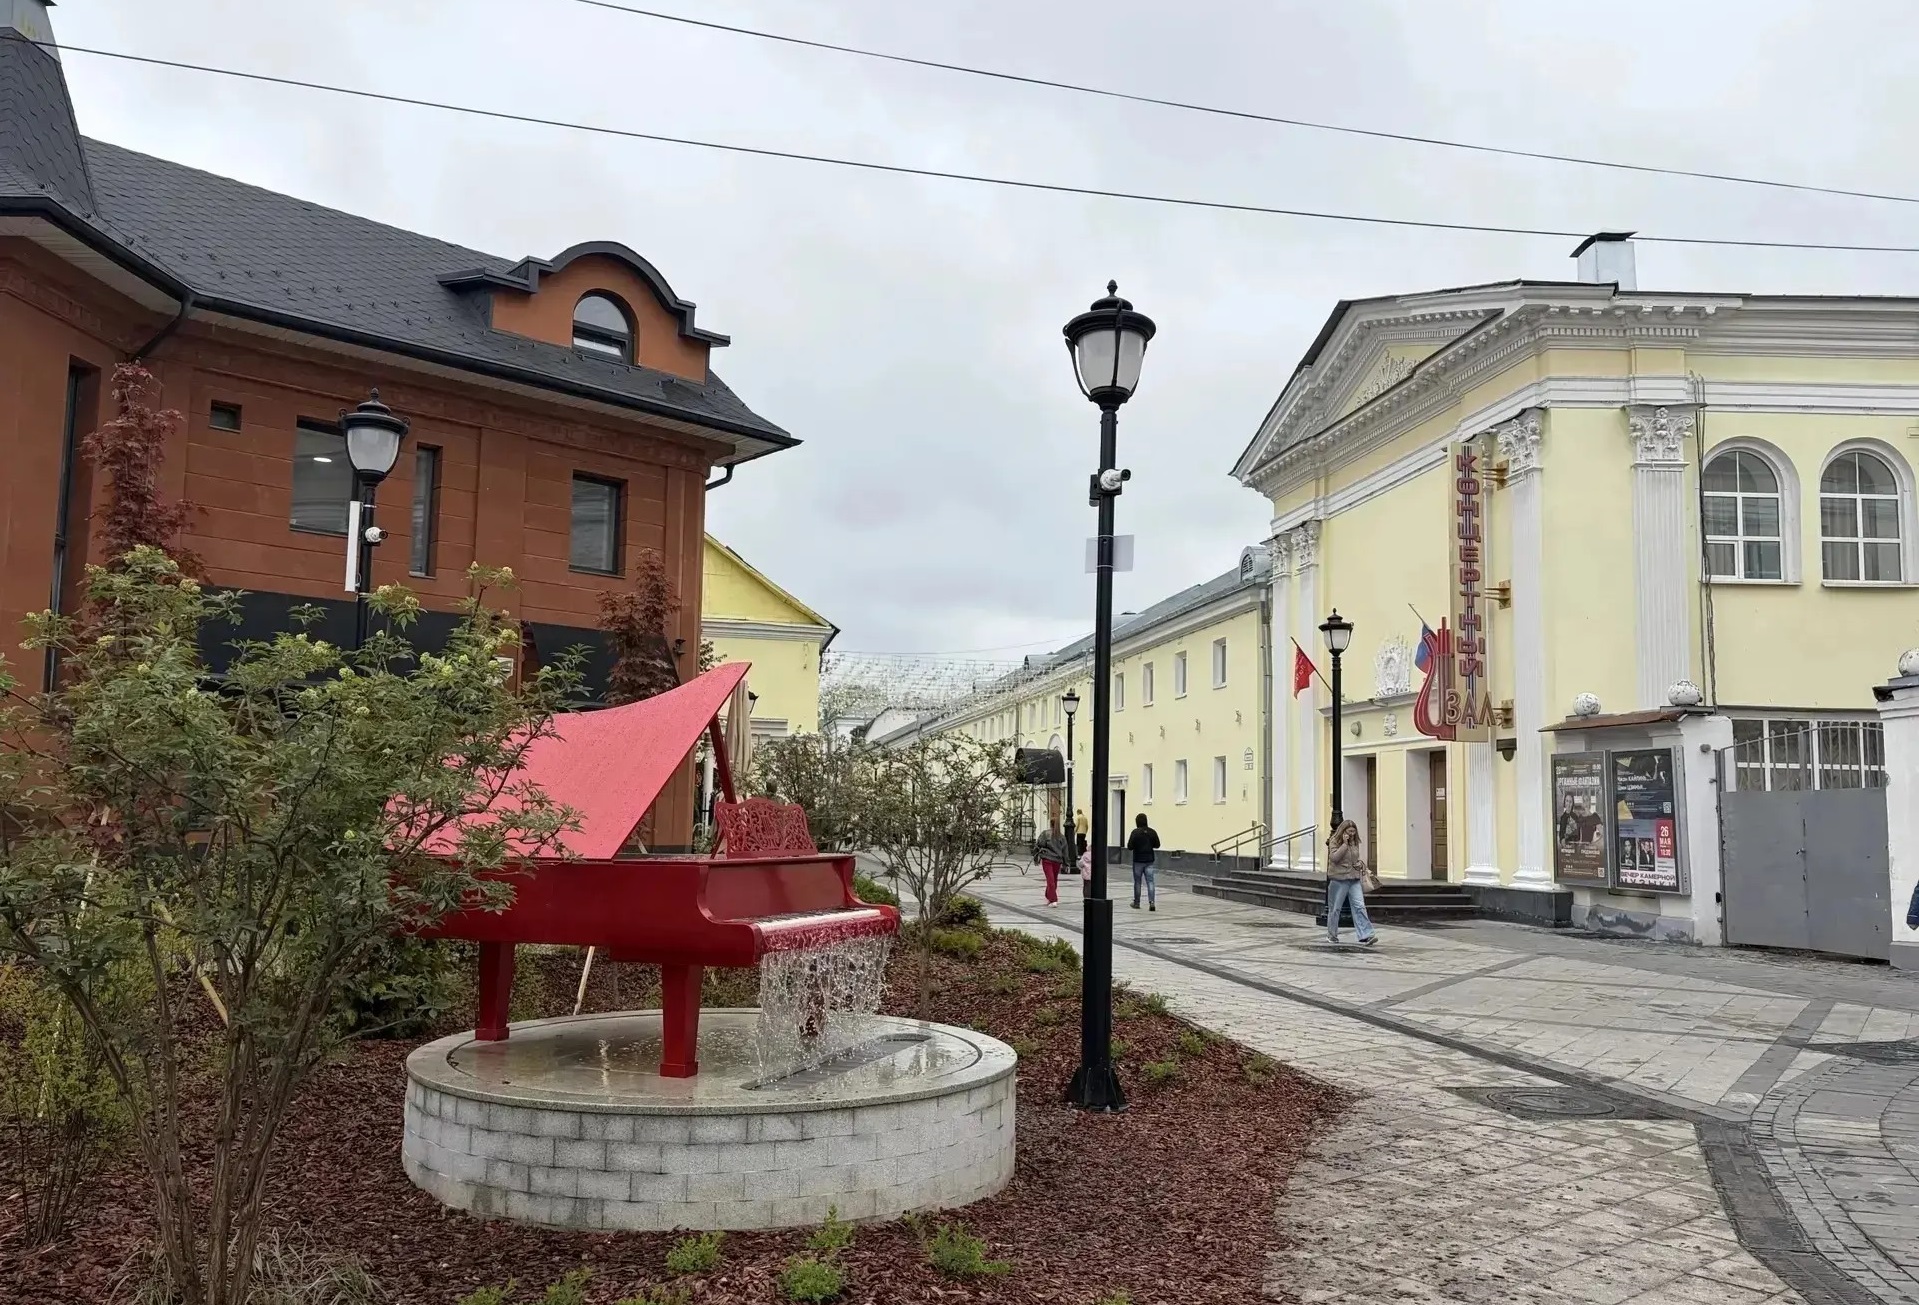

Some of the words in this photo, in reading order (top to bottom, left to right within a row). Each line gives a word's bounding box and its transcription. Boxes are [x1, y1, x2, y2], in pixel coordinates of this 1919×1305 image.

[1456, 454, 1486, 678] КОНЦЕРТНЫЙ
[1446, 688, 1496, 726] ЗАЛ
[1660, 825, 1669, 837] 26
[1660, 837, 1672, 846] МАЯ
[1621, 871, 1640, 879] ВЕЧЕР
[1640, 873, 1676, 882] КАМЕРНОЙ
